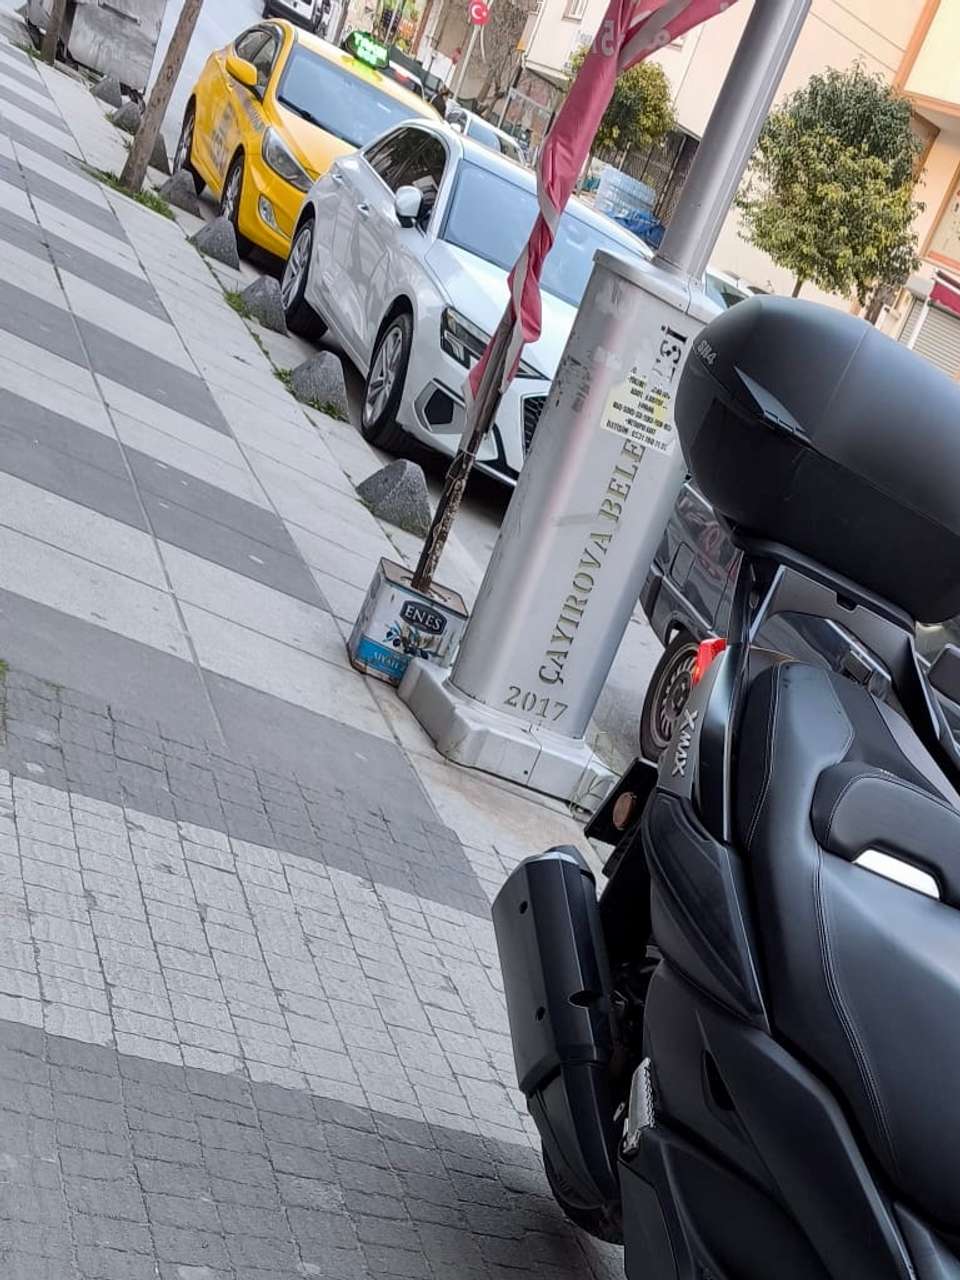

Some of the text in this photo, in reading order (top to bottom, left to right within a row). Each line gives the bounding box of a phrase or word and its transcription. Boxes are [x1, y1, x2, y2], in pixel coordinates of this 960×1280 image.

[404, 605, 442, 630] ENES
[539, 529, 612, 686] ÇAYIROVA
[503, 685, 569, 722] 2017
